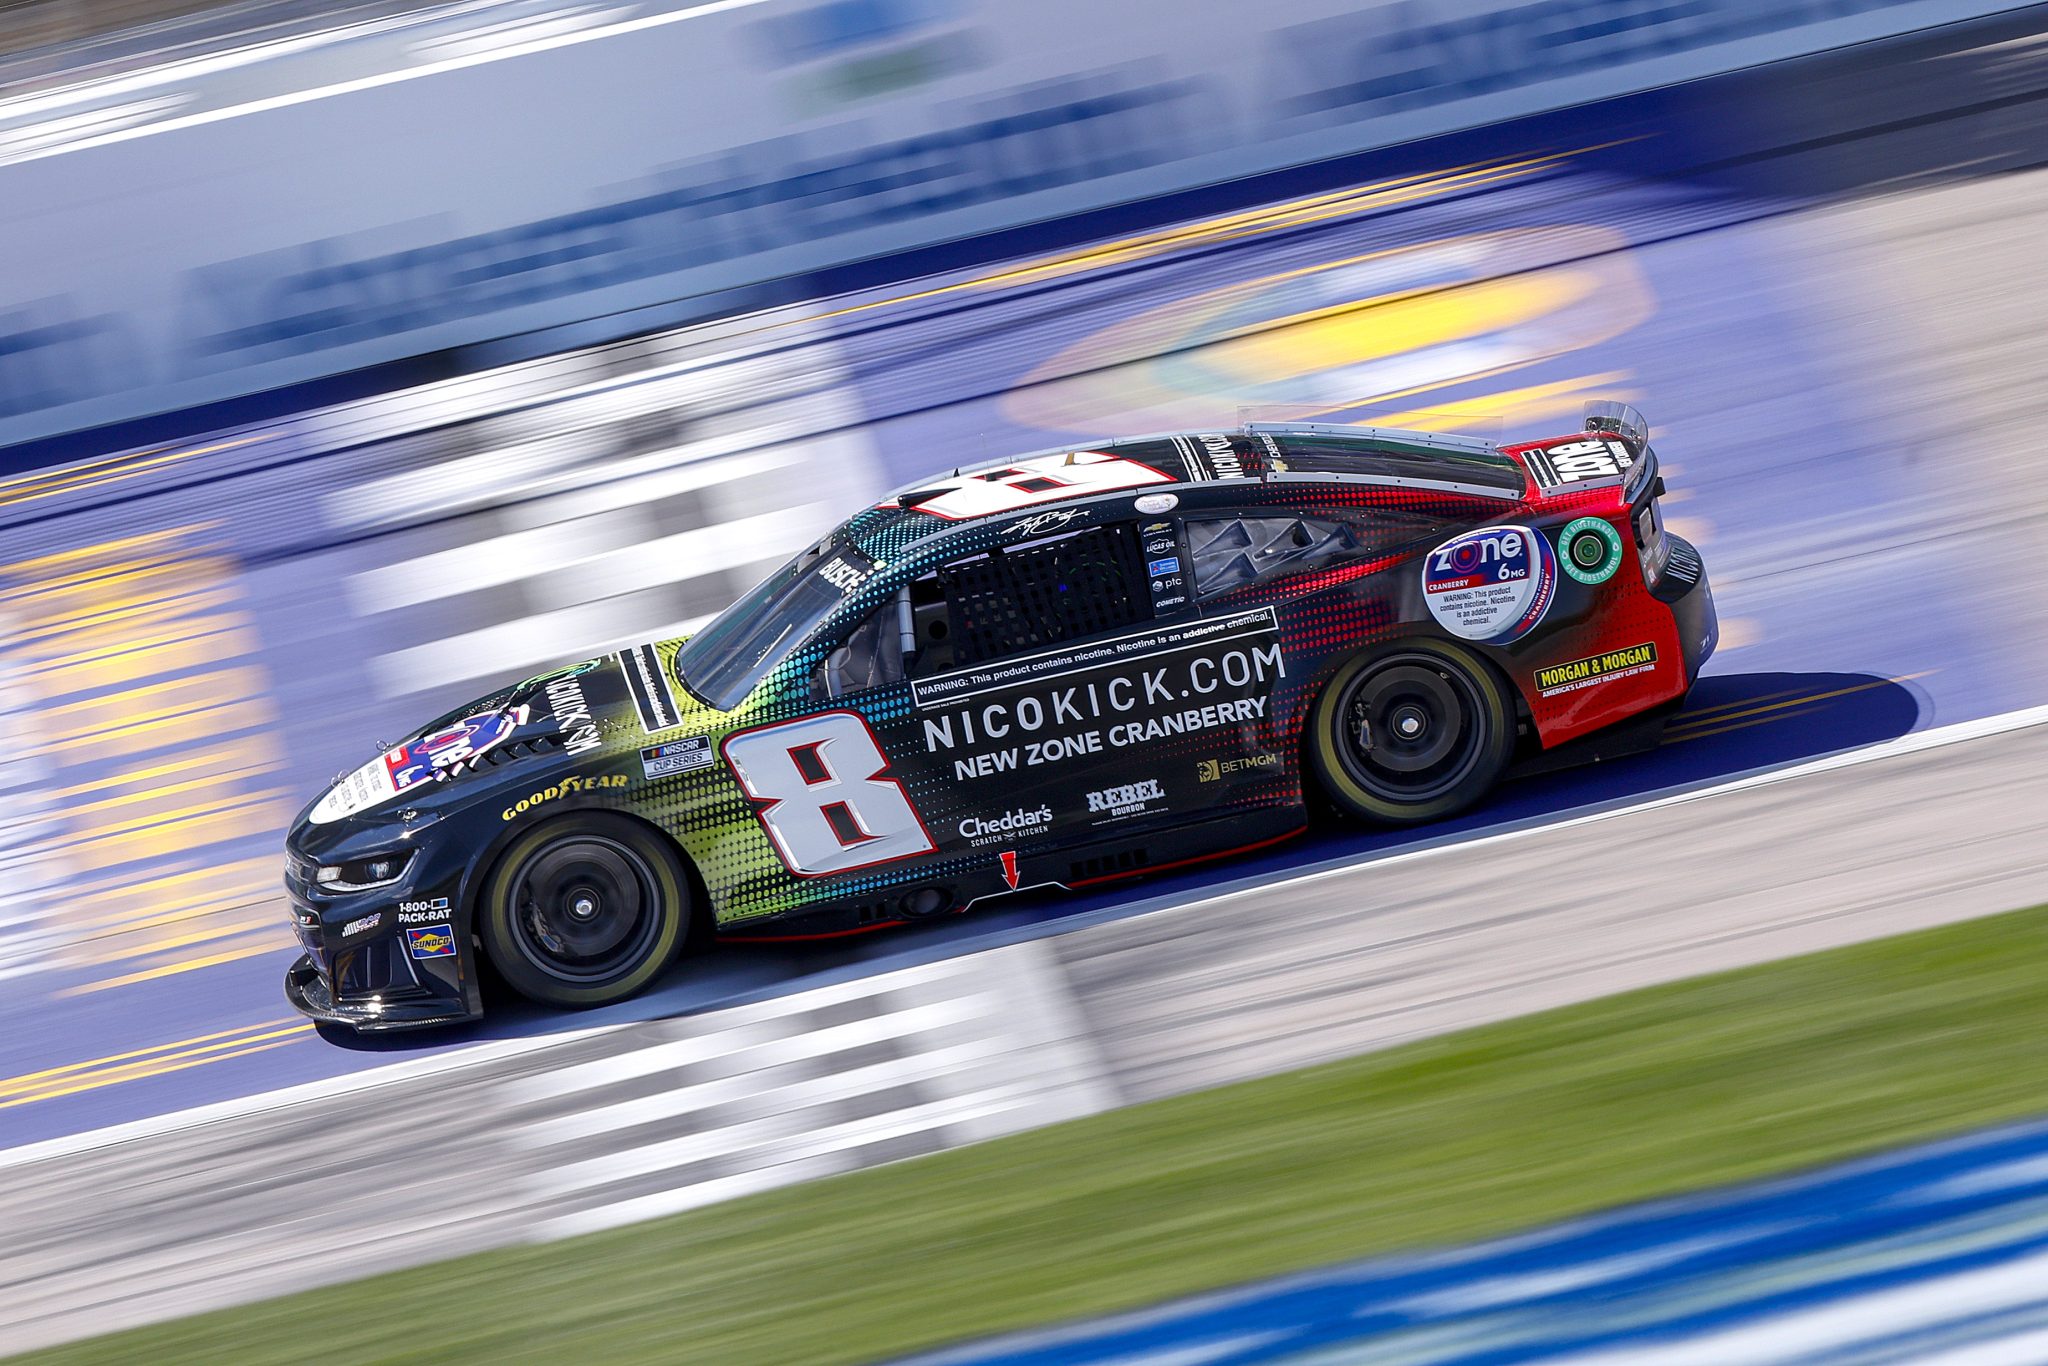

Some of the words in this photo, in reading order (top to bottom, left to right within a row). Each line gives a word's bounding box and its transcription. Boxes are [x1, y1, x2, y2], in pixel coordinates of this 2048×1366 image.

[1146, 542, 1165, 553] LUCAS
[1165, 578, 1182, 590] ptc
[1428, 579, 1469, 592] CRANBERRY
[1440, 602, 1463, 612] contains
[1464, 600, 1489, 610] nicotine.
[1490, 595, 1516, 605] Nicotine
[1443, 592, 1474, 603] WARNING:
[1475, 590, 1487, 598] This
[1488, 586, 1511, 598] product
[1456, 610, 1462, 618] is
[1463, 610, 1470, 618] an
[1471, 606, 1498, 617] addictive
[1463, 616, 1491, 626] chemical.
[917, 678, 969, 696] WARNING:
[970, 674, 992, 685] This
[993, 665, 1031, 682] product
[1032, 656, 1073, 671] contains
[1074, 648, 1116, 663] nicotine.
[1116, 636, 1156, 653] Nicotine
[1157, 635, 1167, 645] is
[1168, 633, 1181, 643] an
[1182, 624, 1226, 640] addictive
[1226, 611, 1272, 629] chemical.
[1541, 661, 1590, 687] MORGAN
[1591, 659, 1601, 674] &
[1601, 646, 1651, 671] MORGAN
[1542, 685, 1575, 698] AMERICA'S
[1575, 677, 1602, 690] LARGEST
[1602, 673, 1625, 683] INJURY
[1625, 668, 1638, 676] LAW
[1639, 664, 1655, 673] FIRM
[923, 643, 1287, 753] NICOKICK.COM
[954, 748, 1018, 781] NEW
[1025, 731, 1103, 767] ZONE
[1108, 696, 1268, 748] CRANBERRY
[663, 740, 700, 756] NASCAR
[654, 759, 671, 771] CUP
[672, 753, 703, 767] SERIES
[1220, 753, 1278, 774] BETMGM
[502, 774, 628, 821] GOODYEAR
[720, 709, 941, 878] 8
[1086, 779, 1166, 813] REBEL
[1111, 802, 1146, 817] BOURBON
[958, 804, 1053, 838] Cheddar's
[970, 834, 1003, 848] SCRATCH
[1018, 825, 1049, 839] KITCHEN
[398, 908, 452, 923] PACK-RAT
[412, 937, 450, 949] SUNOCO
